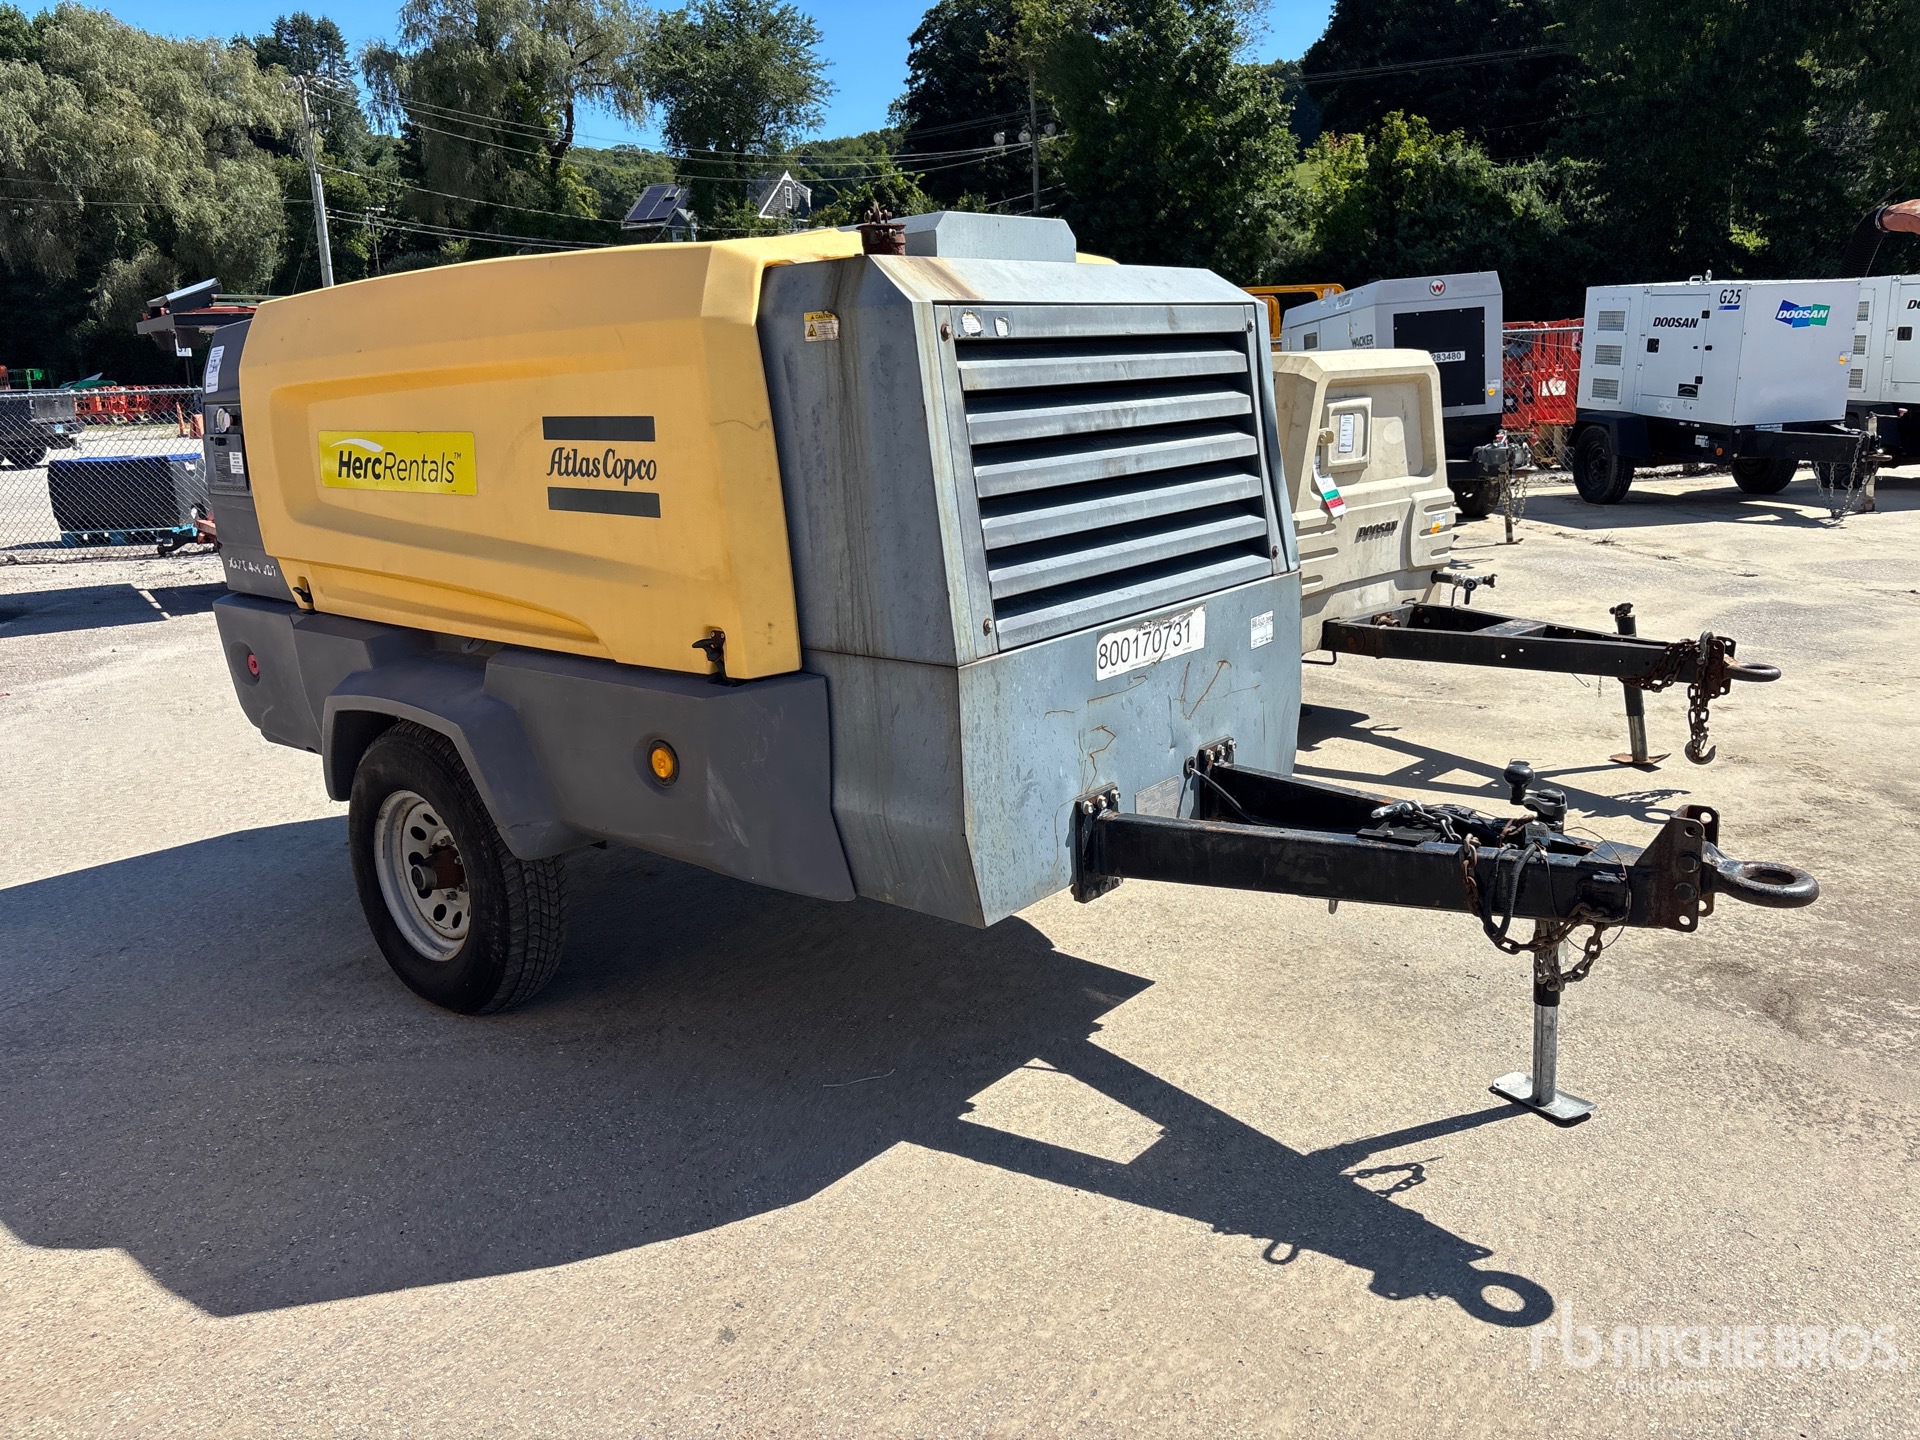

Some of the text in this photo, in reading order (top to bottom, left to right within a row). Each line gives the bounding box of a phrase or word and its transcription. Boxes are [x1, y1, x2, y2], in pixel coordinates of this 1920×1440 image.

[1719, 289, 1742, 304] G25
[1653, 316, 1699, 328] DOOSAN
[1777, 309, 1829, 319] DOOSAN
[1351, 334, 1374, 349] WACKER
[337, 450, 455, 484] HercRentals
[546, 447, 657, 486] Atlas Copco
[1357, 520, 1398, 537] DOOSAN
[1098, 619, 1190, 670] 800170731
